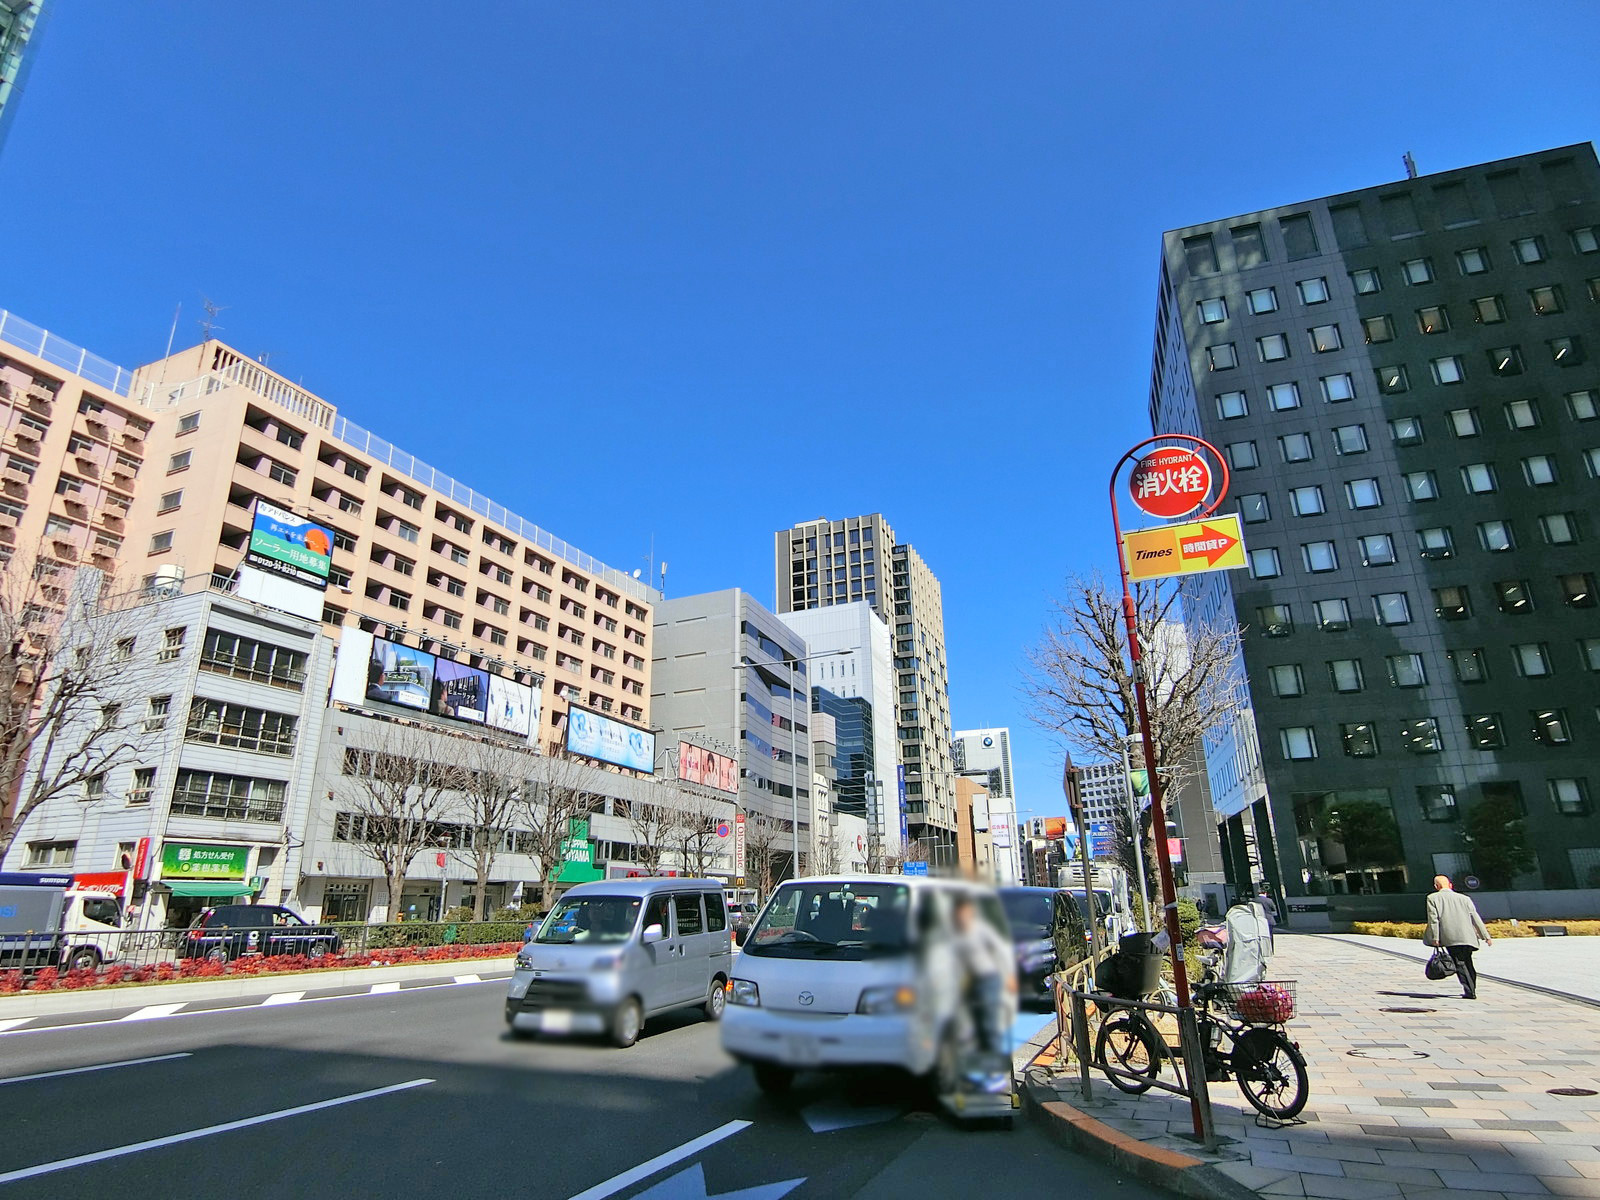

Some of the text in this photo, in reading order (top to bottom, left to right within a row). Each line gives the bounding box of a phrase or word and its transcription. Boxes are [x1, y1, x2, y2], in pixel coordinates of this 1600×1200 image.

[1140, 454, 1193, 468] FIRE HYDRANT
[1136, 467, 1204, 499] 消火栓
[1182, 538, 1228, 554] 時間貸P
[1136, 548, 1173, 561] Times
[737, 826, 745, 869] Olympic
[192, 851, 235, 861] 処方せん受付
